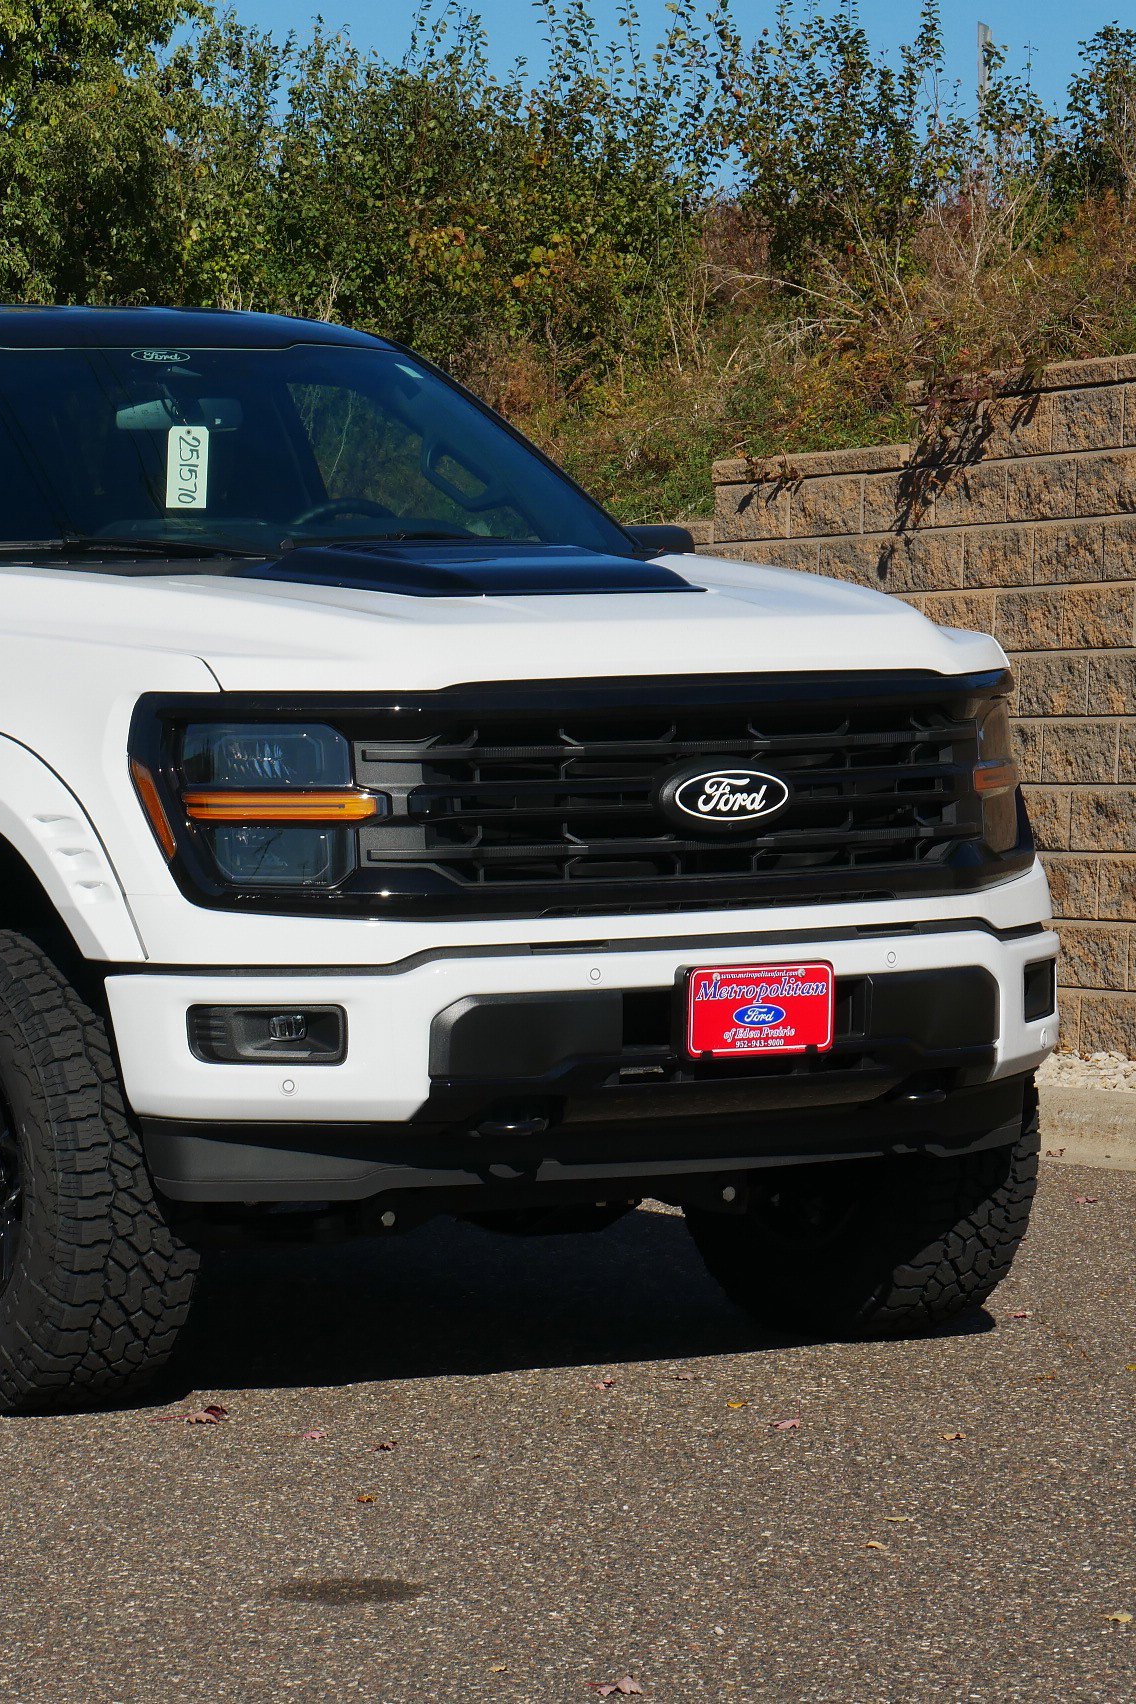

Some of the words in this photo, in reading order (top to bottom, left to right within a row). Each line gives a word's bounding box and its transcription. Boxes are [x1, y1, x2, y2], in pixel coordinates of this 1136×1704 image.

[143, 351, 180, 360] Ford
[177, 435, 200, 504] 251570
[697, 777, 768, 812] Ford
[695, 977, 827, 1003] Metropolitan
[744, 1008, 774, 1022] Ford
[723, 1028, 736, 1042] of
[735, 1028, 760, 1039] Eden
[761, 1026, 795, 1037] Prairie
